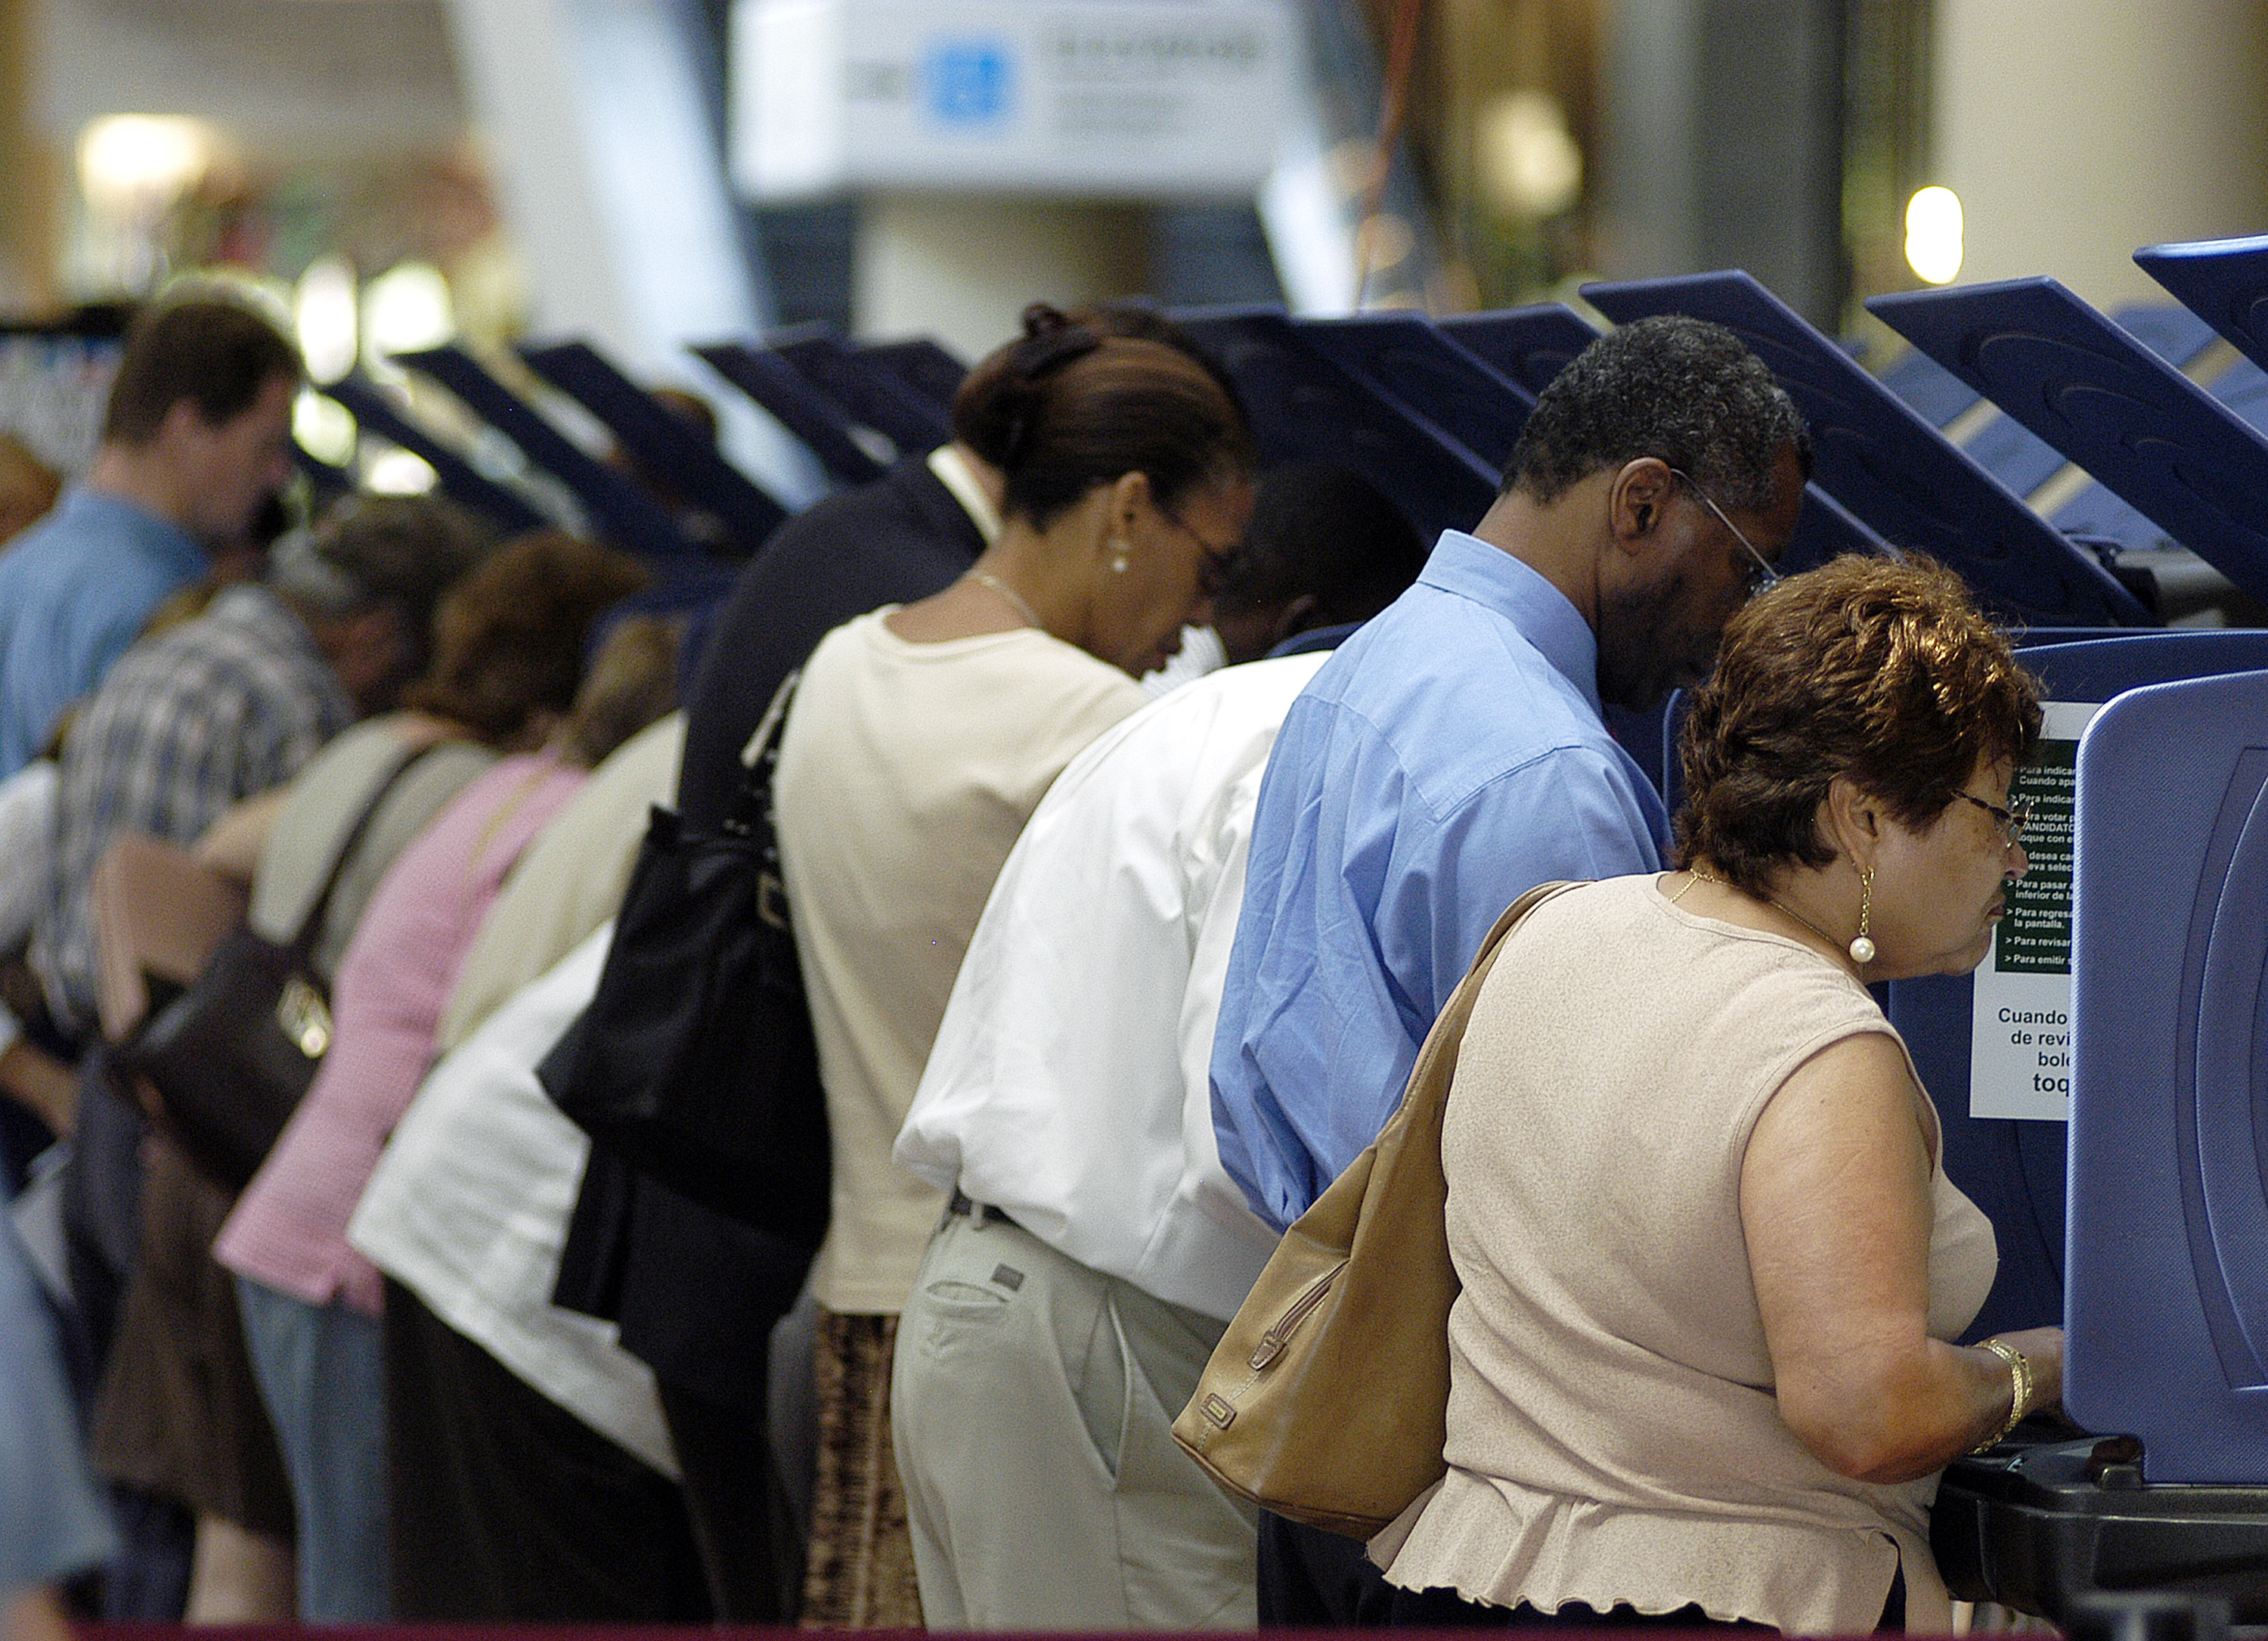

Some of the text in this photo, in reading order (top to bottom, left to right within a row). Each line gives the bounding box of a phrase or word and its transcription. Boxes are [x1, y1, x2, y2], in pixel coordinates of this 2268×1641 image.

[2019, 776, 2056, 786] Cuando
[2019, 793, 2040, 802] Para
[2025, 823, 2074, 833] ANDIDATO
[2028, 852, 2057, 861] desea
[2015, 879, 2037, 889] Para
[2040, 882, 2068, 891] pasar
[2015, 889, 2050, 899] inferior
[2015, 907, 2037, 917] Para
[2014, 919, 2065, 929] la pantalla.
[2013, 936, 2071, 947] Para revisar
[2013, 954, 2035, 963] Para
[2037, 955, 2065, 965] emitir
[1998, 1007, 2068, 1025] Cuando
[2011, 1030, 2070, 1046] de revi
[2038, 1051, 2069, 1067] bol
[2033, 1073, 2069, 1097] toq
